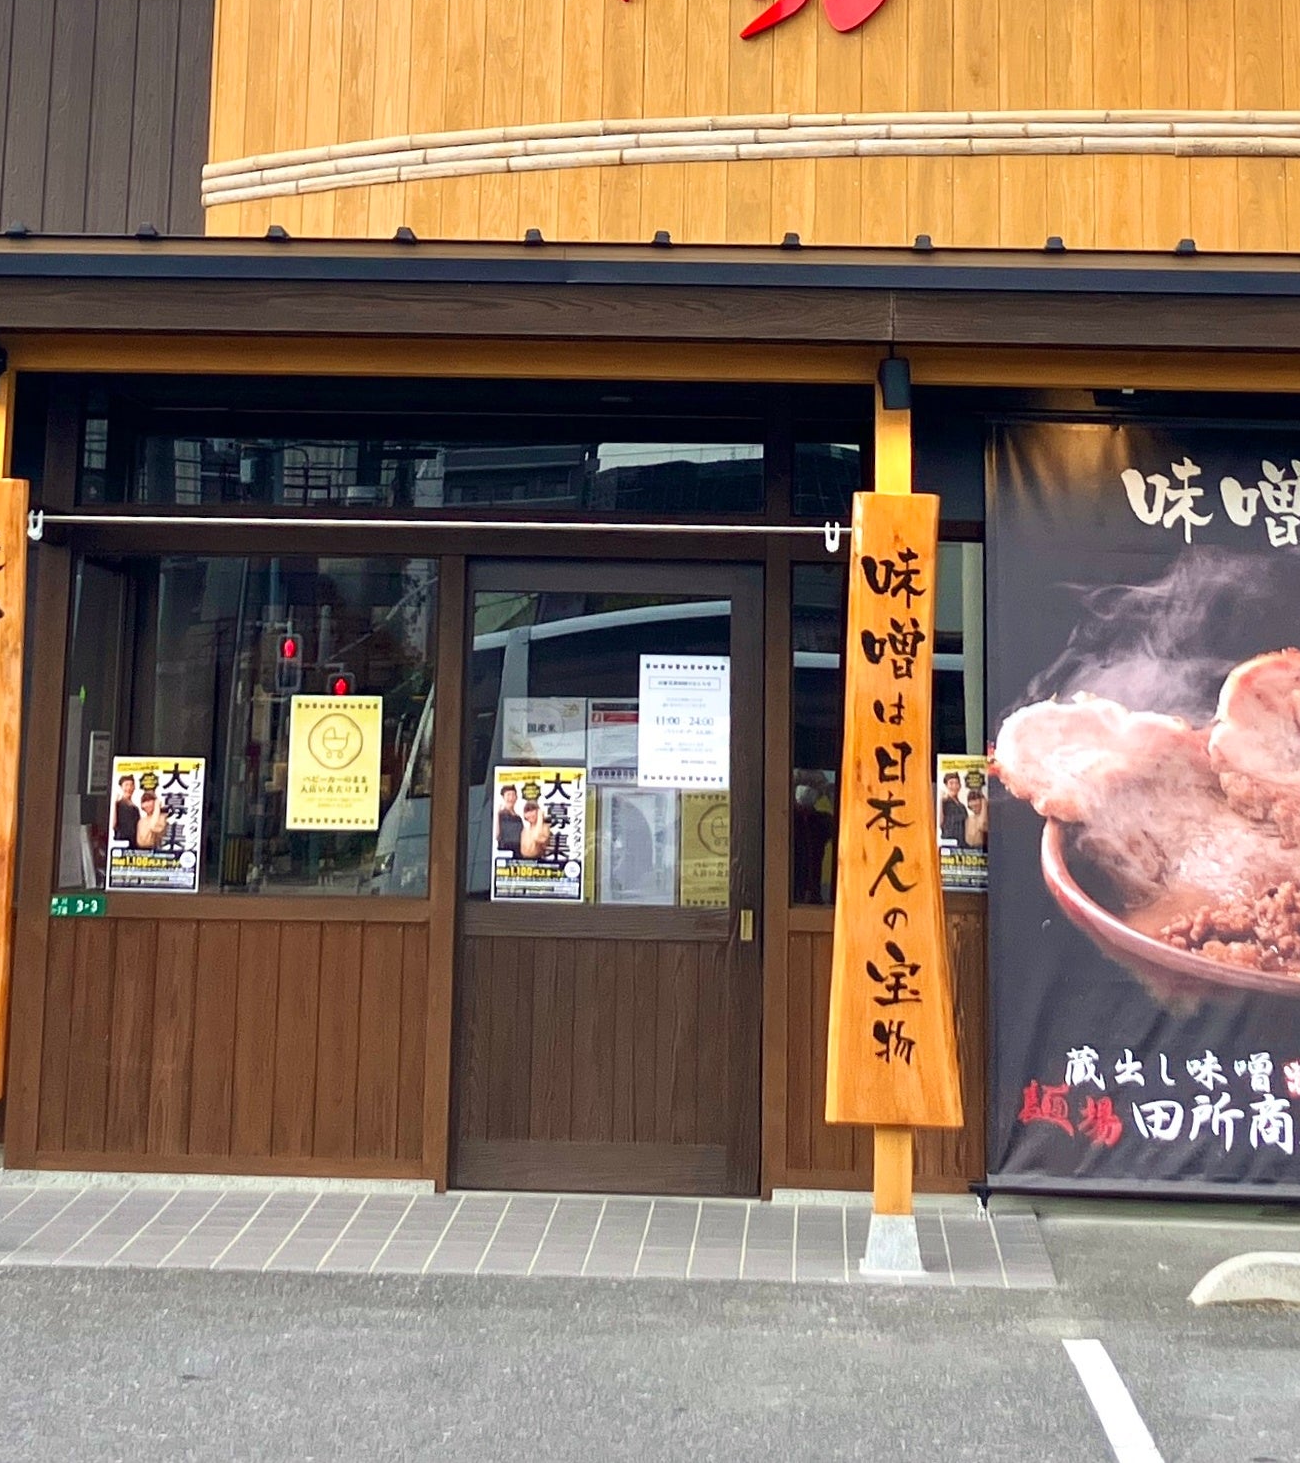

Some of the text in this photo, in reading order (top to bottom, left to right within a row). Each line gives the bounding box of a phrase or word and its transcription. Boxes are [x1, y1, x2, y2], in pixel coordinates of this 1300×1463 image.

[161, 763, 189, 850] 大募集
[543, 772, 572, 862] 大募集
[859, 546, 927, 1067] 味噌は日本人の宝物
[1064, 1045, 1274, 1093] 蔵出し味噌
